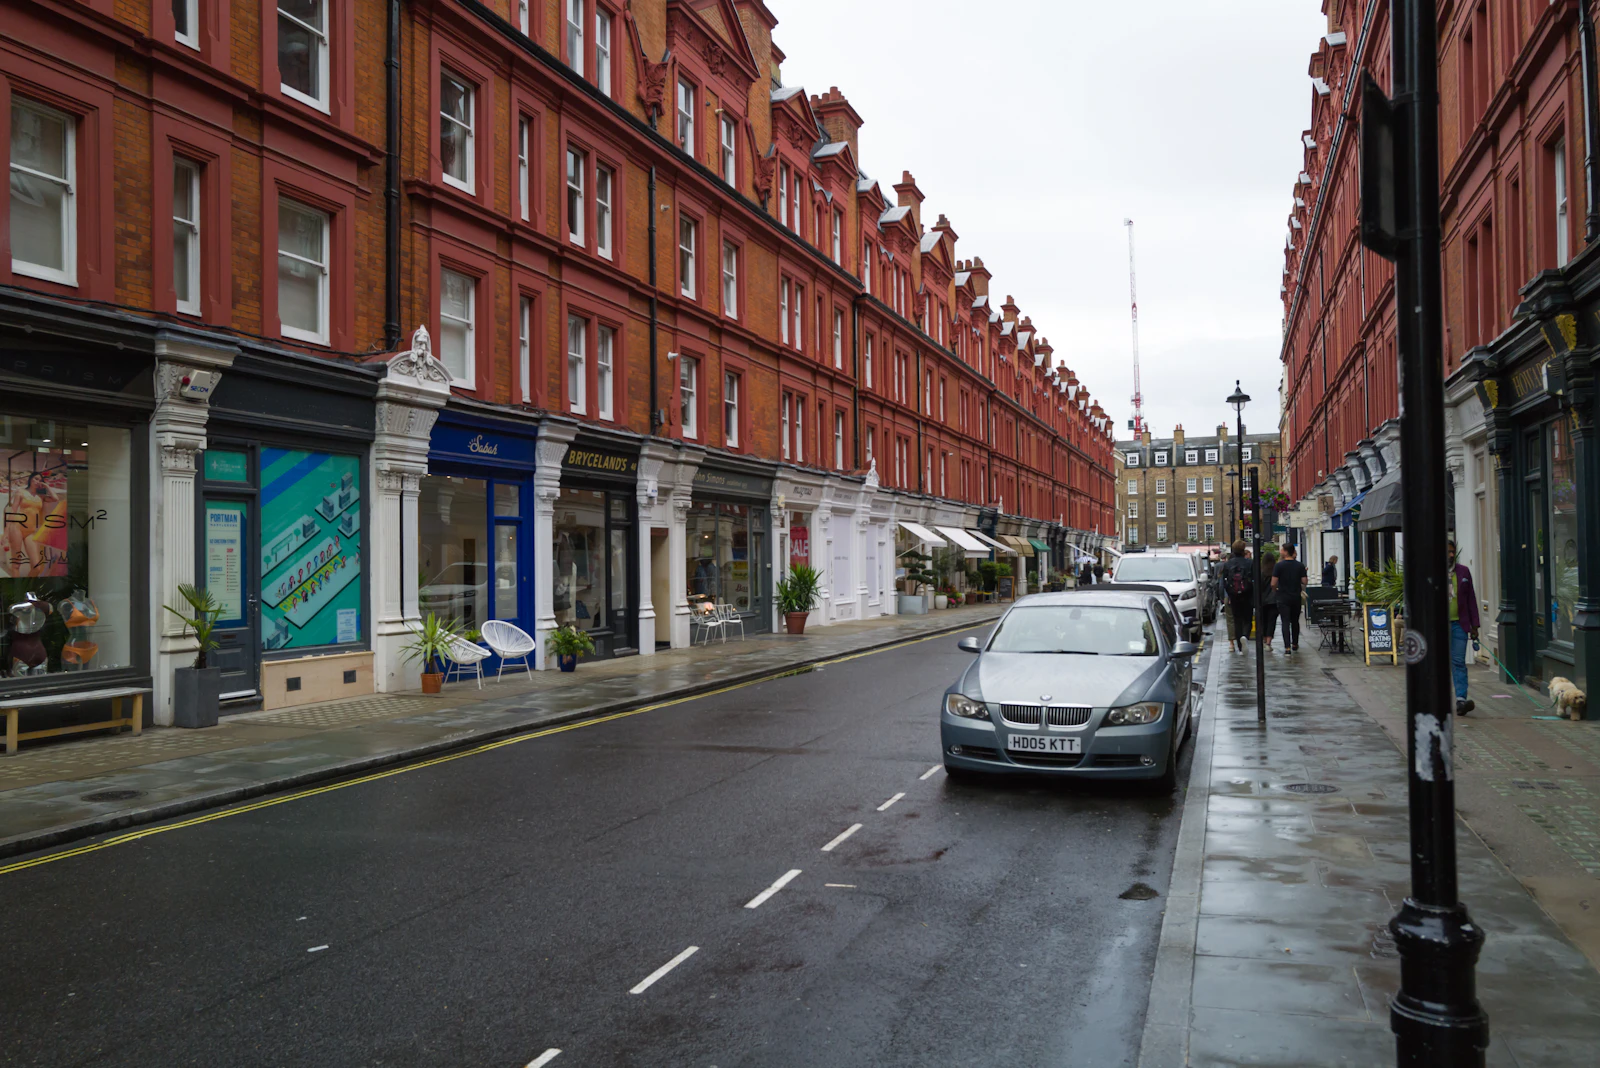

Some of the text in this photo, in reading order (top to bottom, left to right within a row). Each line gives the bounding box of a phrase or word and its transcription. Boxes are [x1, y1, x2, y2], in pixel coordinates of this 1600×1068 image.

[13, 359, 121, 386] PRISM
[469, 434, 499, 455] Sabah
[568, 450, 628, 472] BRYCELAND'S
[694, 473, 706, 482] ohn
[210, 513, 238, 523] PORTMAN
[1368, 635, 1391, 643] SEATING
[1013, 736, 1075, 751] HD05 KTT
